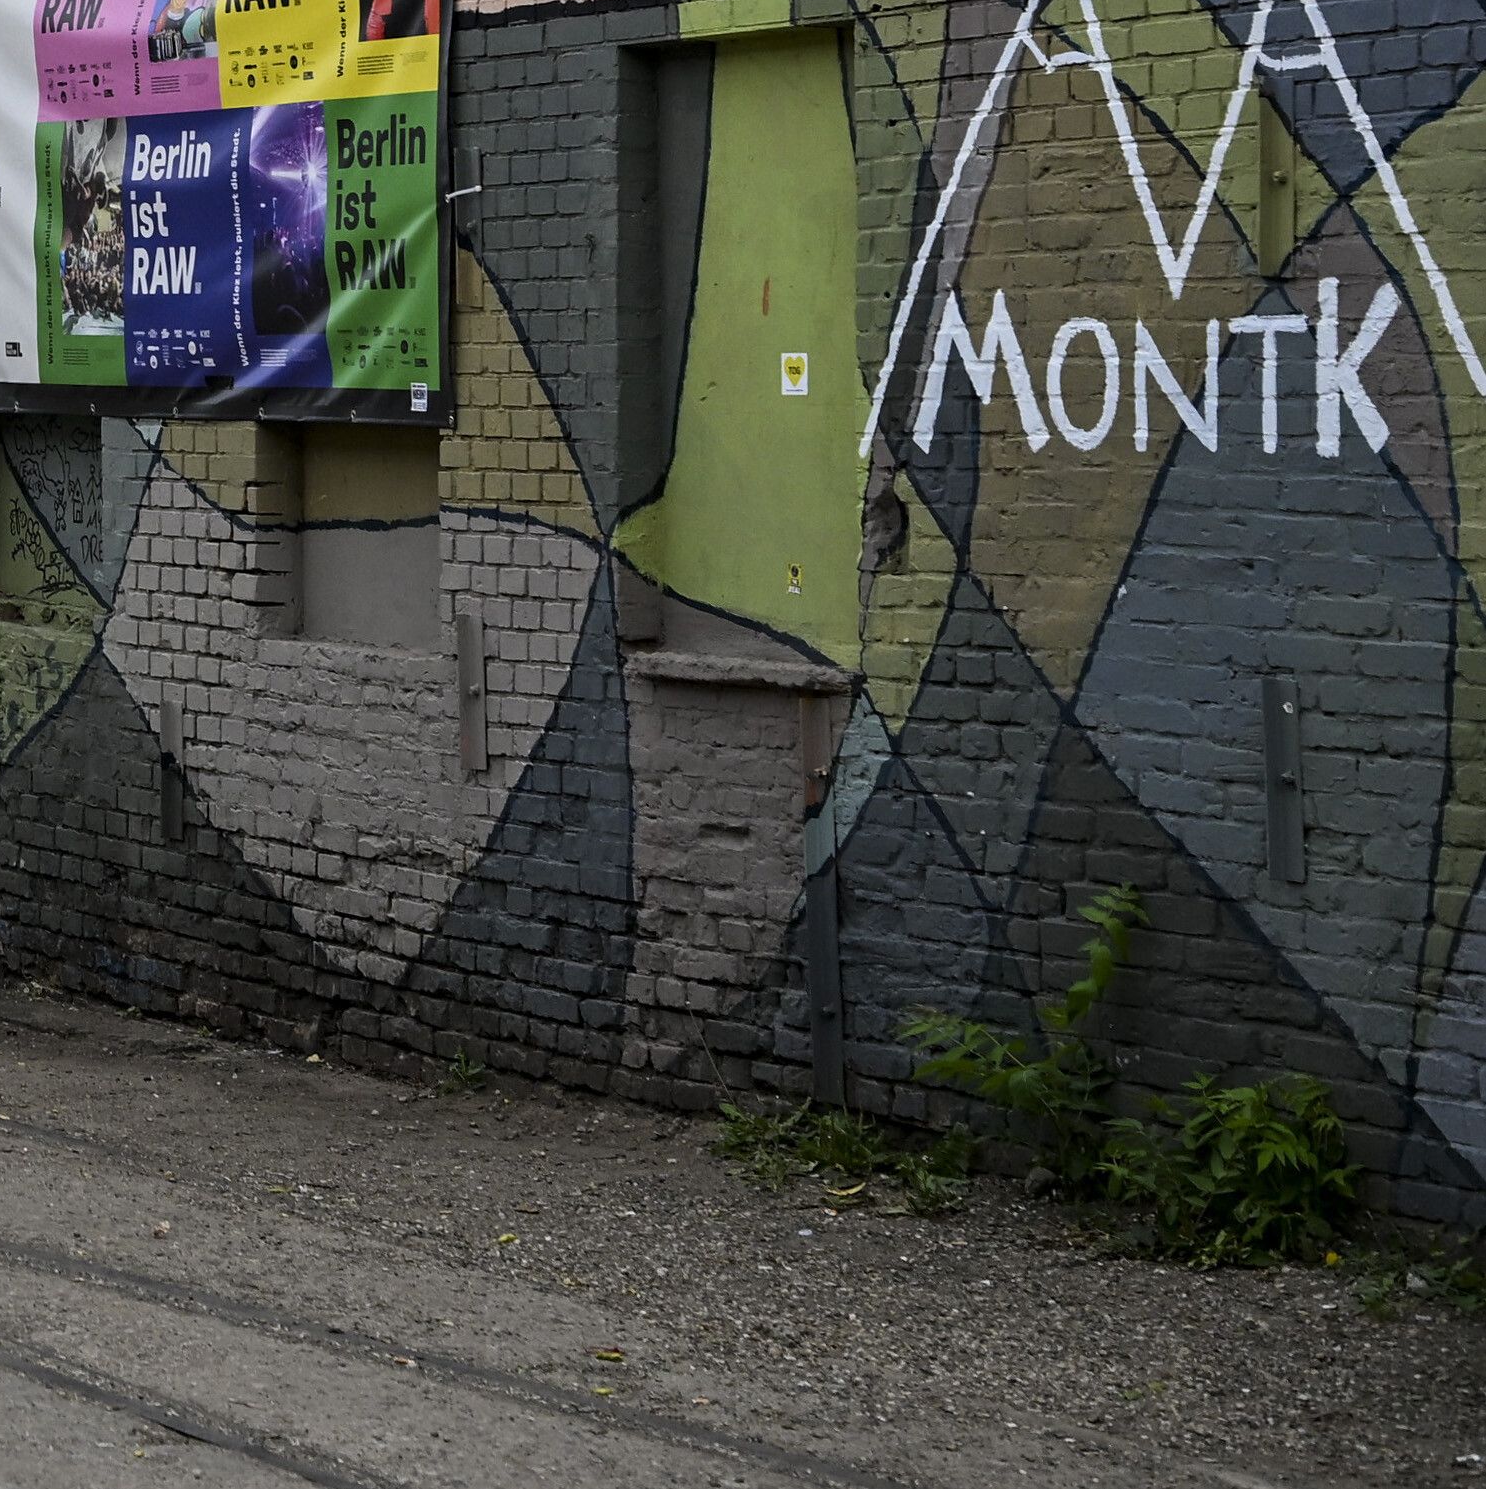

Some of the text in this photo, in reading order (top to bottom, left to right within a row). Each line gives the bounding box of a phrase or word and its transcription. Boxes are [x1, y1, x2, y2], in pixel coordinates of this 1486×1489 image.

[338, 17, 346, 38] der
[336, 42, 346, 77] Wenn
[131, 130, 211, 181] Berlin
[337, 113, 426, 169] Berlin
[130, 191, 169, 238] ist
[335, 180, 376, 230] ist
[233, 309, 241, 329] der
[236, 332, 249, 366] Wenn
